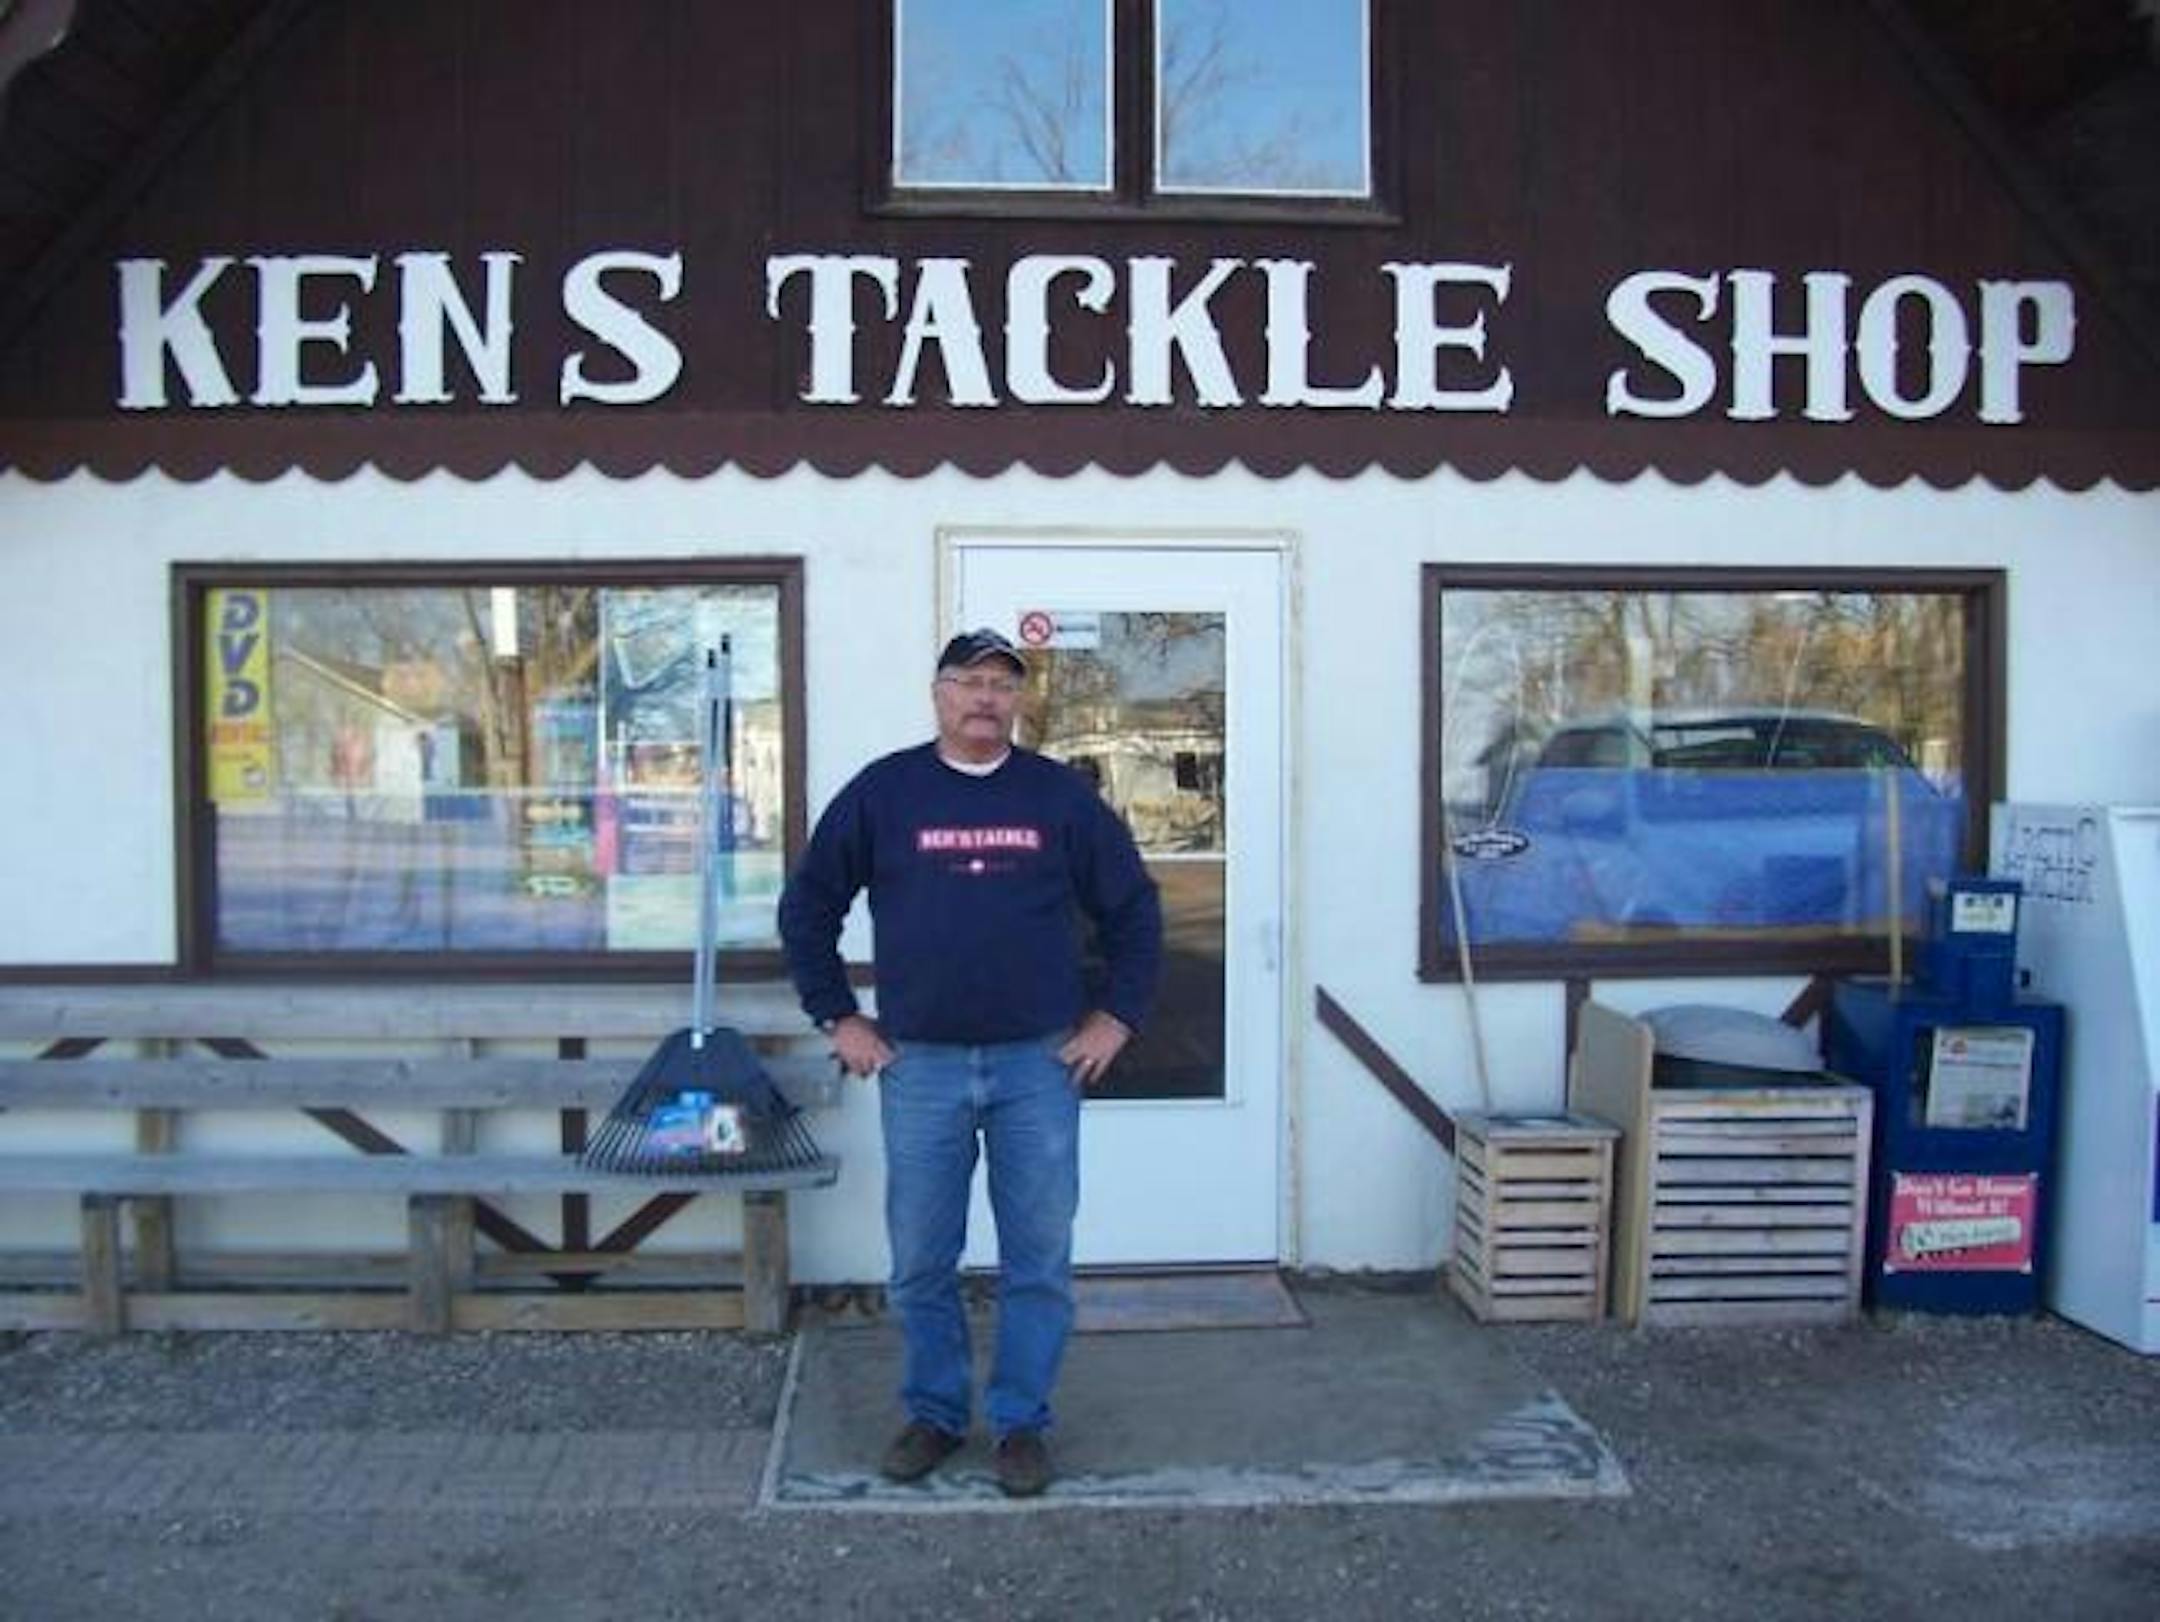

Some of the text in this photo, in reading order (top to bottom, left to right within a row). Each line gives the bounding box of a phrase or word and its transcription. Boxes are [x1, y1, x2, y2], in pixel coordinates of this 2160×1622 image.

[766, 254, 1515, 412] TACKLE
[1606, 268, 2077, 425] SHOP
[218, 595, 260, 717] DVD
